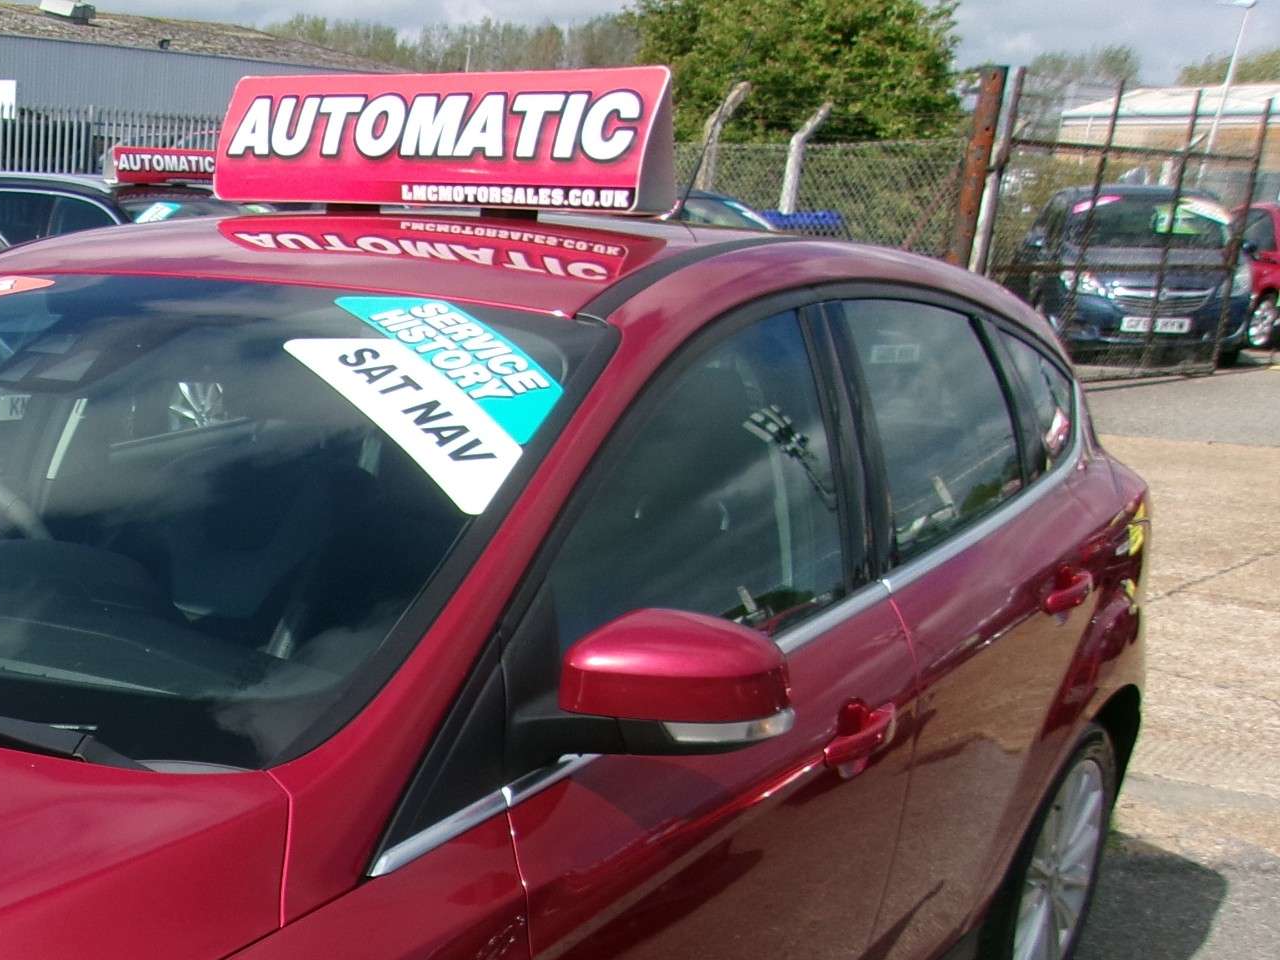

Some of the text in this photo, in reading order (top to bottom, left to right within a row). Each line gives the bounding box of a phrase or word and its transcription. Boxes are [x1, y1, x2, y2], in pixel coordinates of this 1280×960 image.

[118, 152, 216, 173] AUTOMATIC
[227, 89, 642, 162] AUTOMATIC
[400, 184, 631, 209] LMCMOTORSALES.CO.UK
[370, 308, 515, 399] HISTORY
[409, 302, 551, 395] SERVICE
[338, 347, 497, 462] SAT NAV
